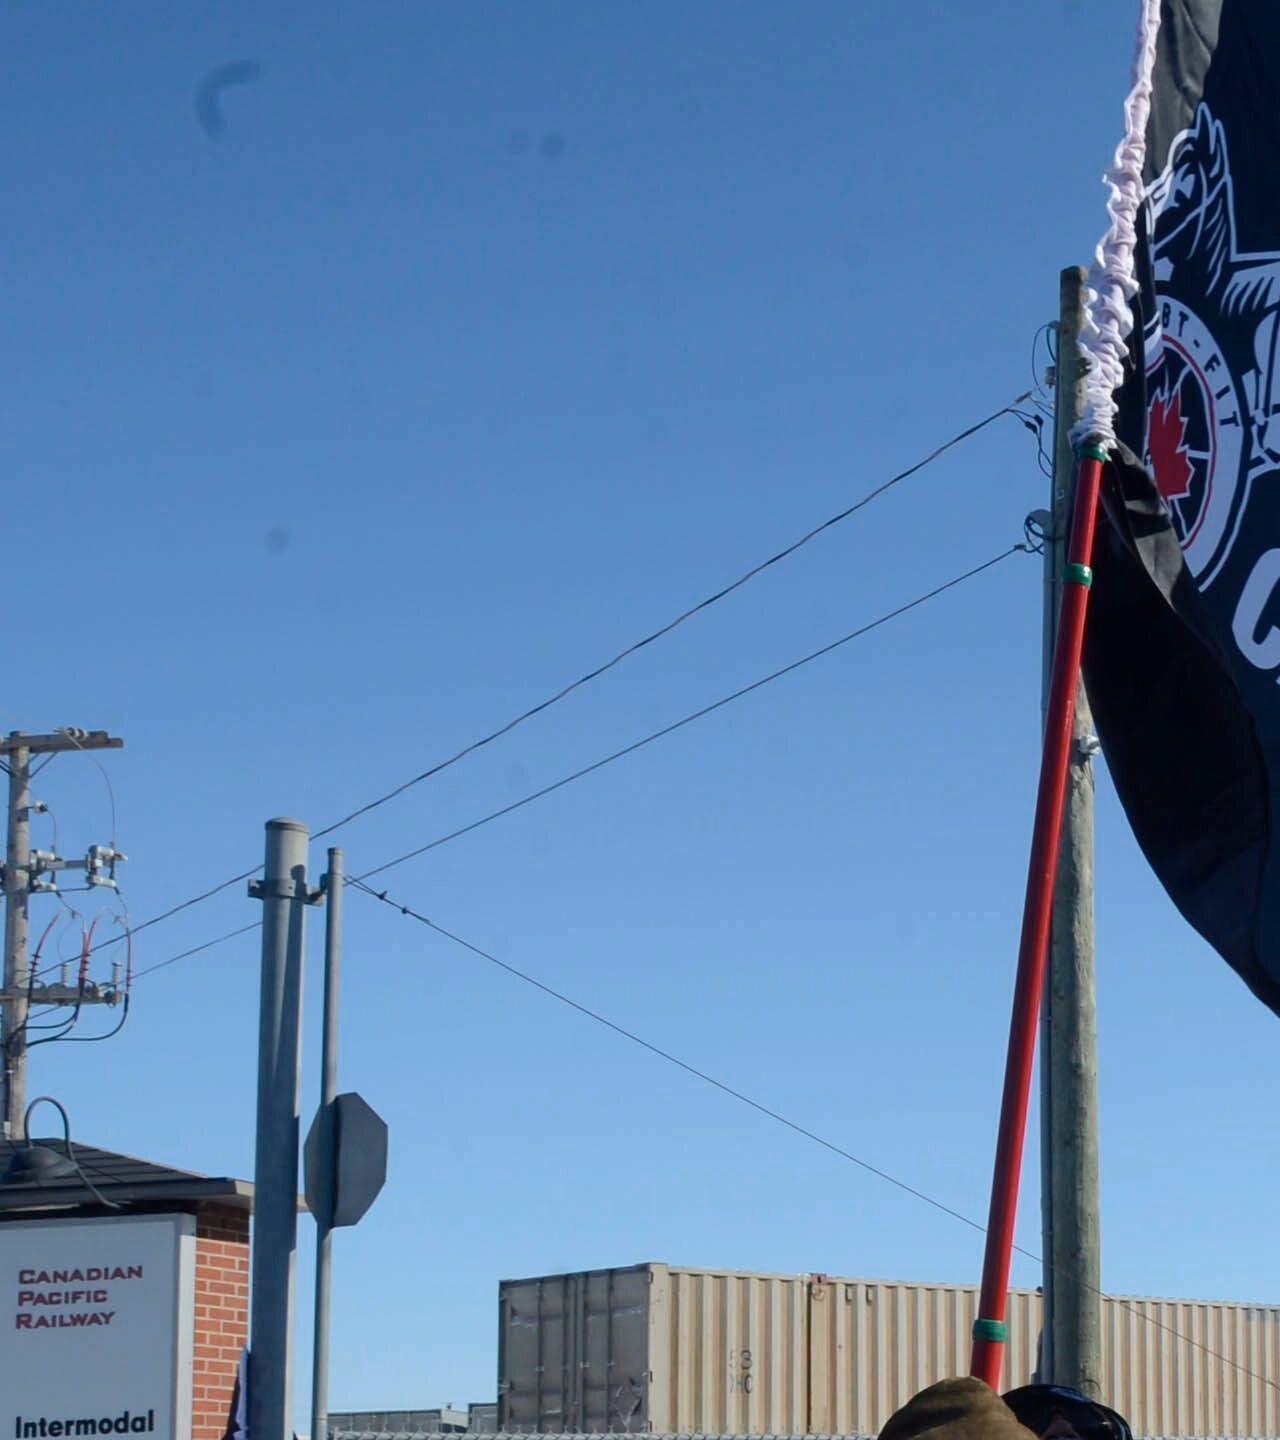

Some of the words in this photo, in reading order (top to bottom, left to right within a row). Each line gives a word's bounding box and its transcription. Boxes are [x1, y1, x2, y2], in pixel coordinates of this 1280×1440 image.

[18, 1265, 143, 1285] CANADIAN
[17, 1289, 108, 1306] PACIFIC
[15, 1311, 116, 1330] RAILWAY
[15, 1409, 155, 1439] Intermodal
